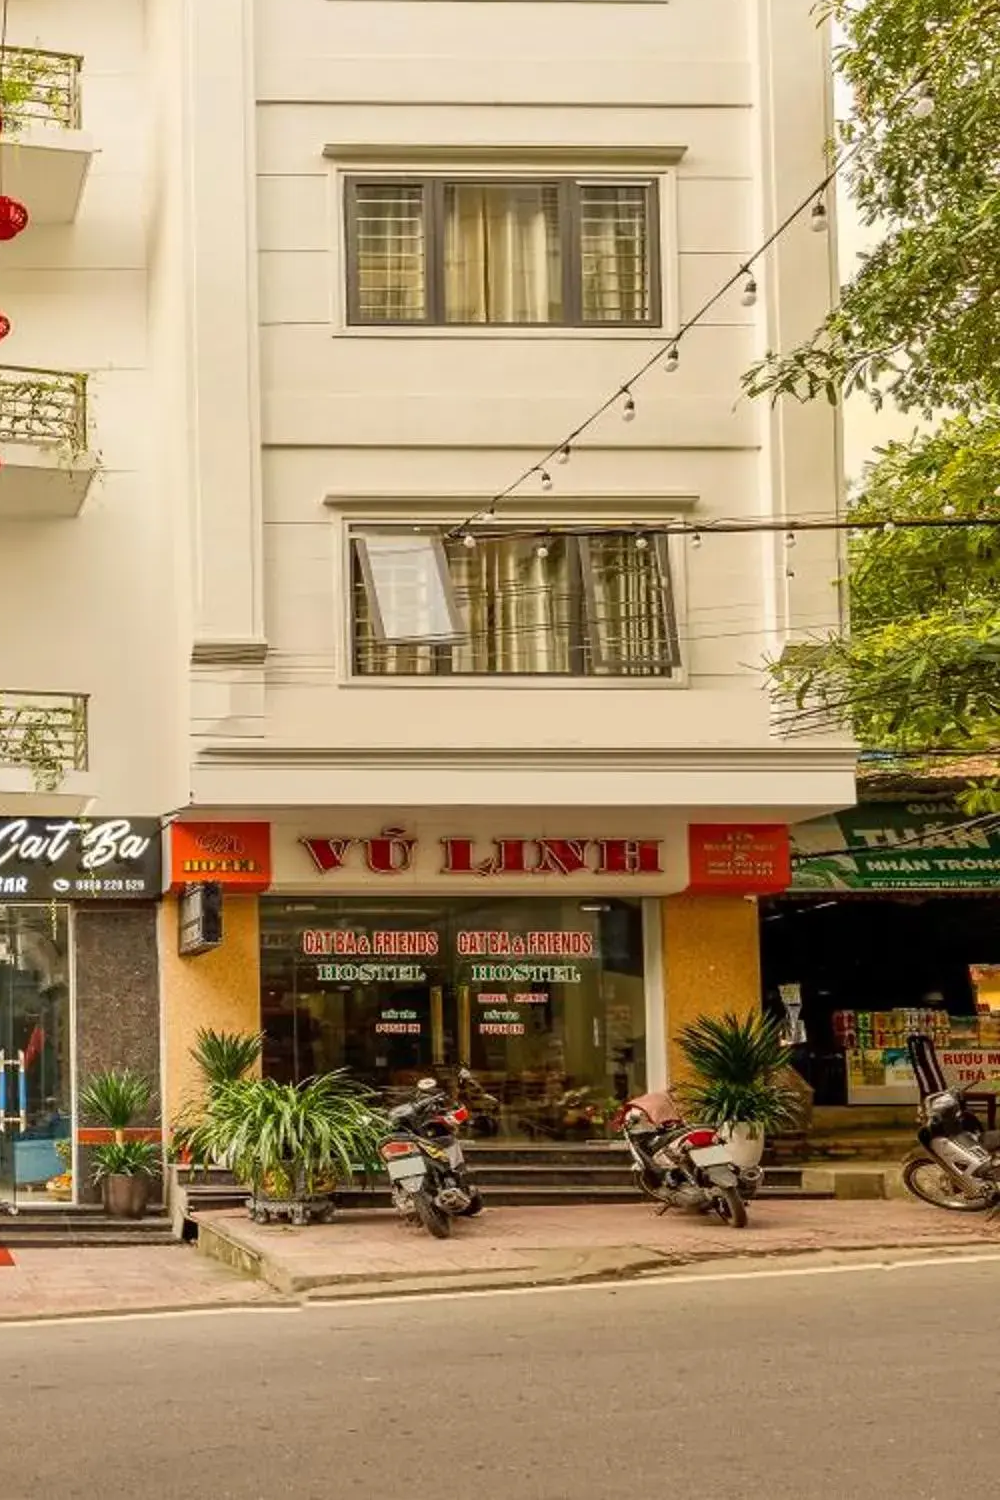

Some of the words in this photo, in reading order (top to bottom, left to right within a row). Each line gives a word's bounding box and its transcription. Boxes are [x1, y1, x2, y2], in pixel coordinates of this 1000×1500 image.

[81, 819, 150, 869] Ba
[297, 825, 419, 875] VŨ
[439, 835, 665, 877] LINH
[303, 930, 333, 955] CAT
[334, 930, 357, 955] BA
[358, 935, 371, 955] &
[373, 930, 439, 955] FRIENDS
[457, 931, 487, 955] CAT
[488, 931, 511, 955] BA
[512, 936, 526, 955] &
[527, 931, 593, 955] FRIENDS
[317, 963, 427, 982] HOSTEL
[471, 964, 582, 983] HOSTEL
